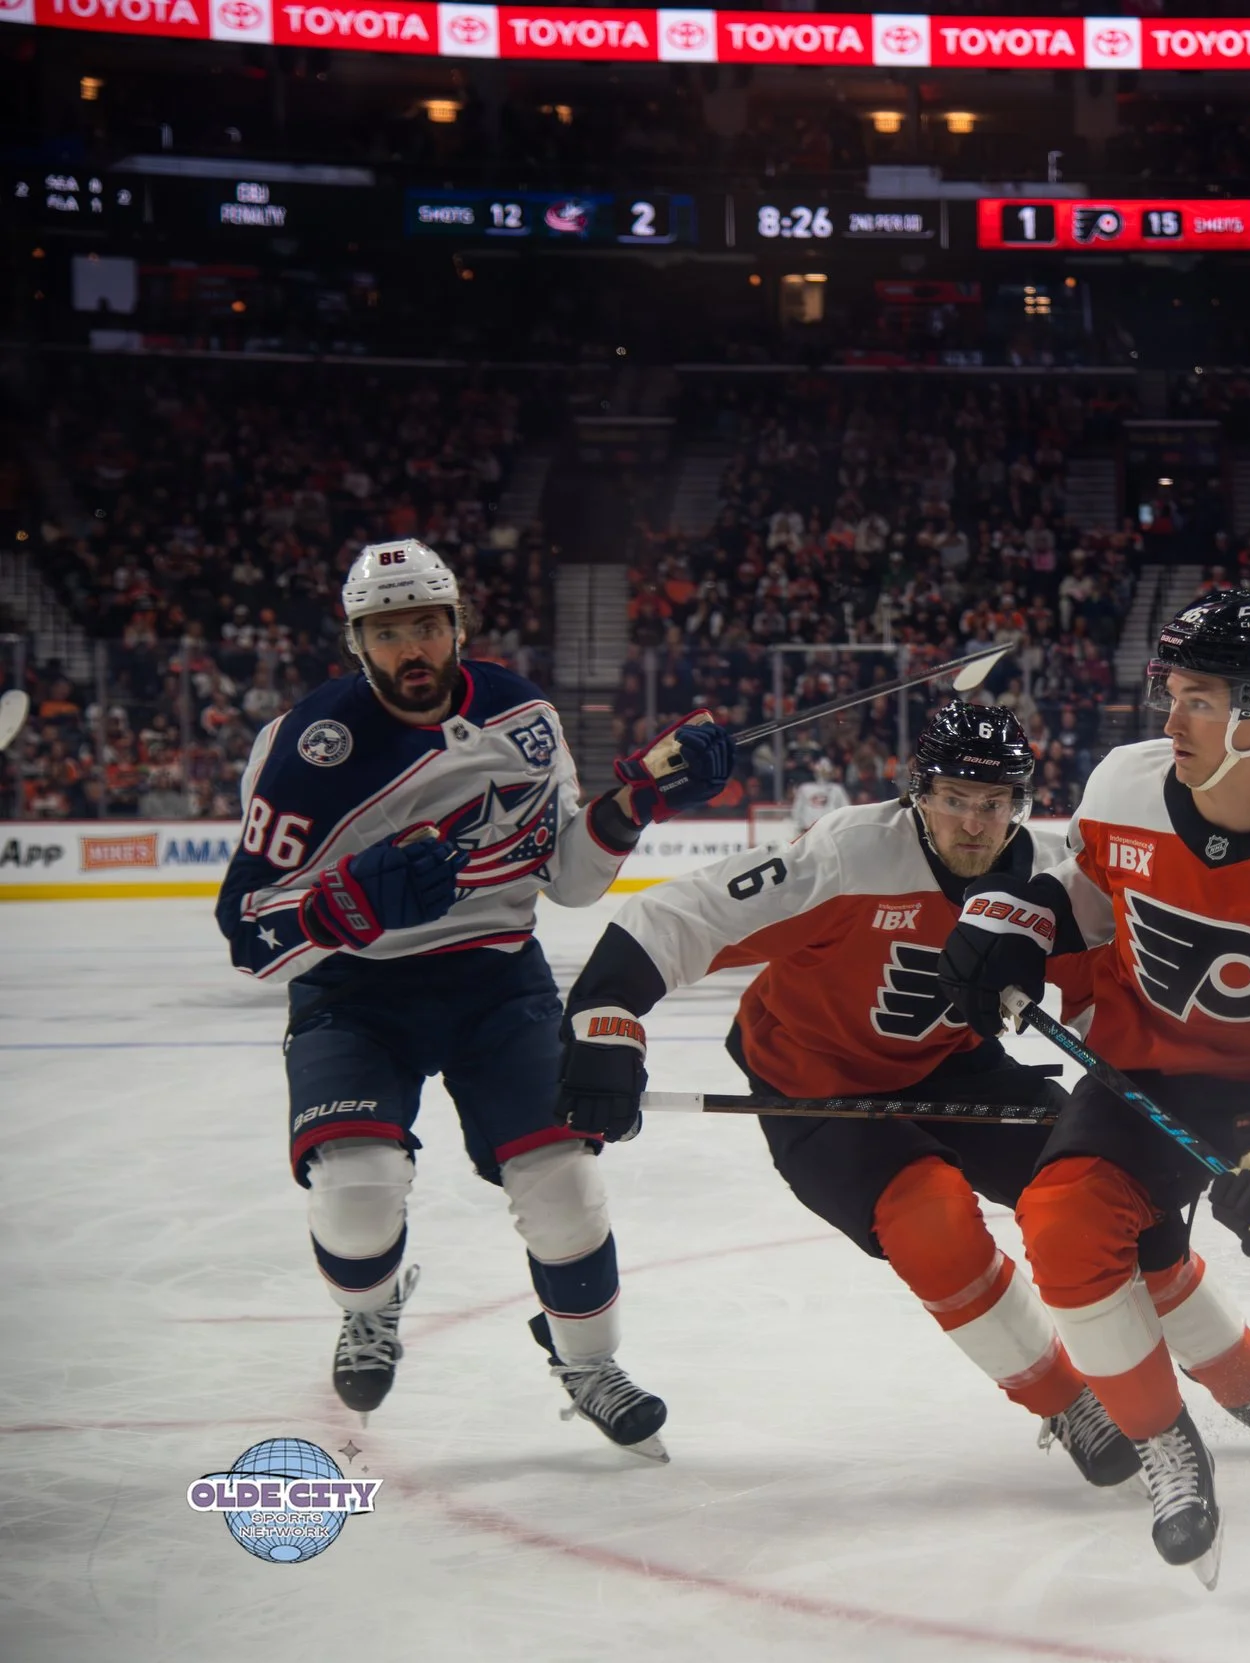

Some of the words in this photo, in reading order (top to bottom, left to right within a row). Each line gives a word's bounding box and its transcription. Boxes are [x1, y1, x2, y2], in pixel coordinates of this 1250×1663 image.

[285, 6, 429, 40] TOYOTA
[510, 19, 649, 48] TOYOTA
[727, 23, 864, 53] TOYOTA
[940, 28, 1076, 57] TOYOTA
[418, 205, 475, 224] SHOTS
[490, 203, 522, 228] 12
[630, 202, 656, 236] 2
[758, 206, 833, 238] 8:26
[1018, 206, 1036, 240] 1
[1149, 211, 1178, 235] 15
[1193, 216, 1244, 233] SHOTS
[1160, 634, 1183, 645] BAUER
[514, 723, 554, 760] 25
[979, 722, 992, 739] 6
[963, 755, 1000, 767] BAUER
[242, 795, 313, 870] 86
[164, 839, 234, 867] AMA
[1109, 842, 1153, 877] IBX
[727, 858, 787, 900] 6
[872, 909, 920, 931] IBX
[966, 898, 1057, 941] BAUE
[1055, 1031, 1097, 1067] BAUER
[293, 1100, 378, 1133] BAUER
